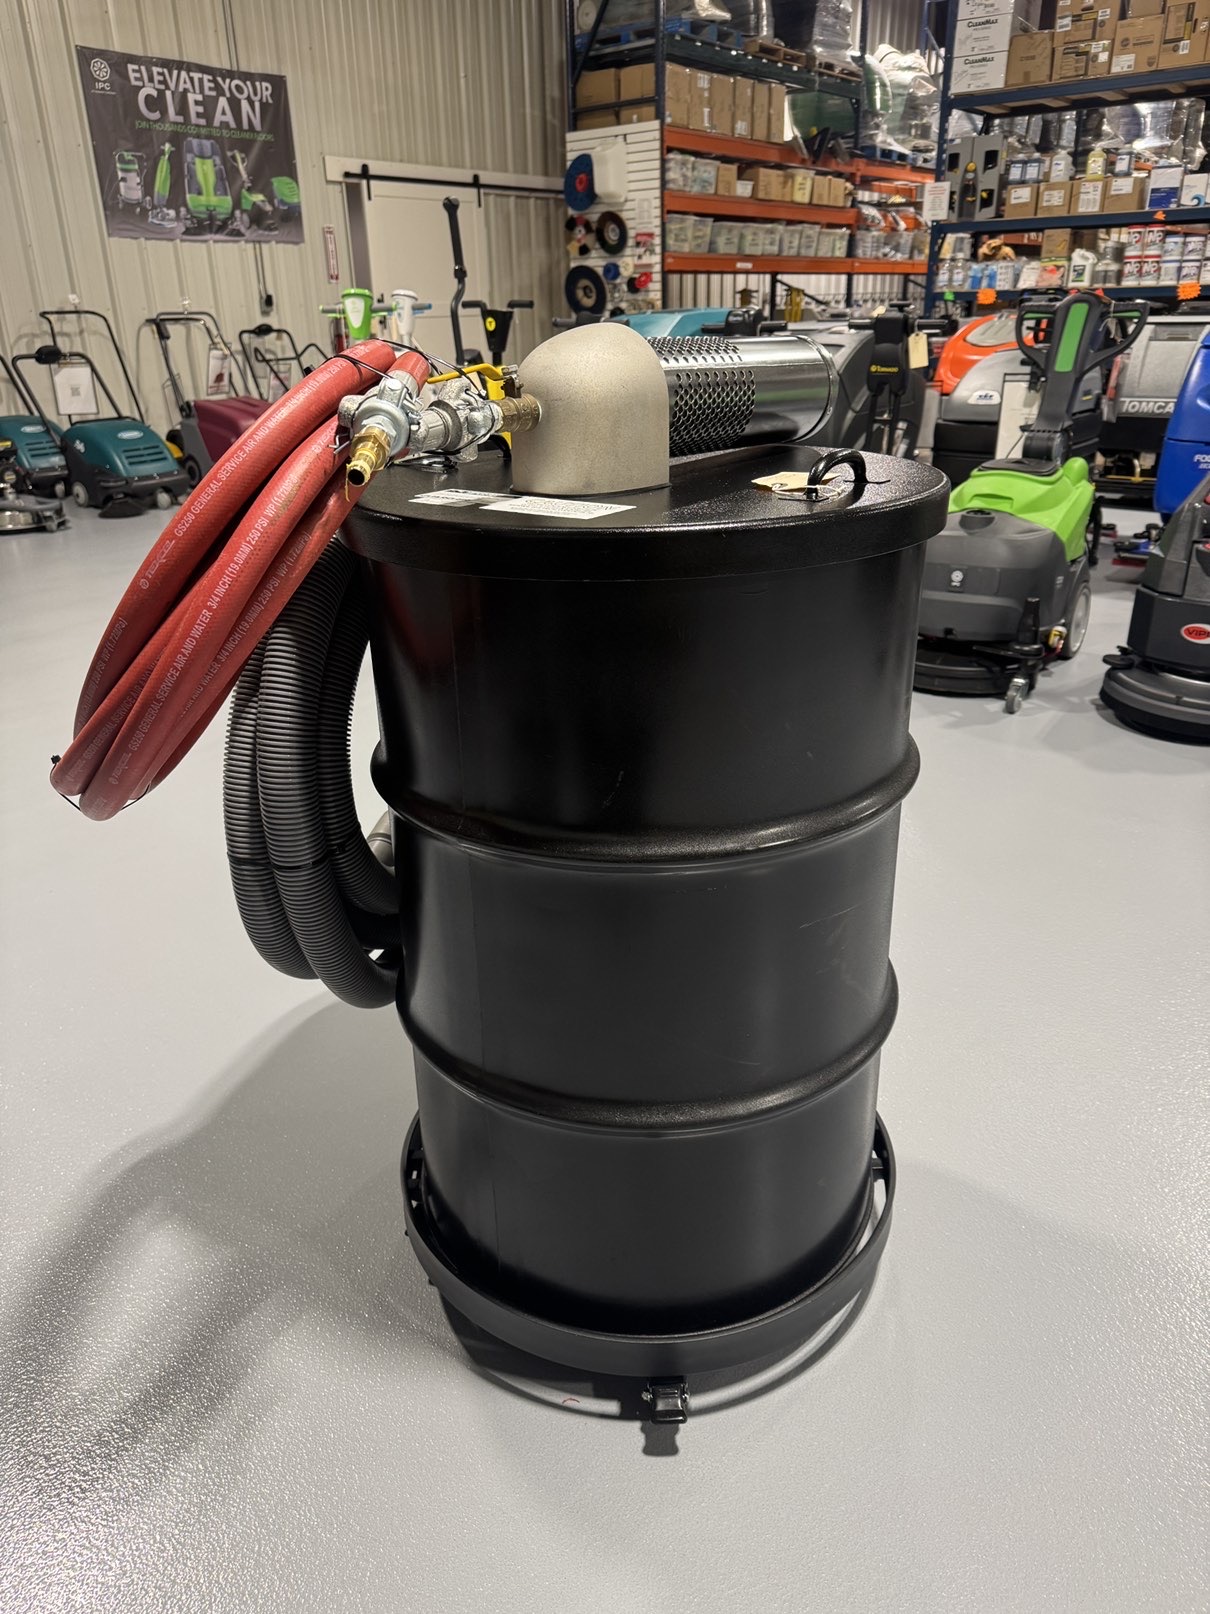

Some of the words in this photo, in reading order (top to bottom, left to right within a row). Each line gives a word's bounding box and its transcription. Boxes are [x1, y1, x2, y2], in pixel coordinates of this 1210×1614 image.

[95, 82, 111, 90] IPC
[127, 63, 217, 96] ELEVATE
[216, 77, 273, 103] YOUR
[138, 86, 262, 132] CLEAN
[174, 514, 195, 537] GS250
[190, 480, 223, 514] GENERAL
[217, 449, 247, 480] SERVICE
[245, 437, 258, 454] AIR
[253, 421, 270, 442] AND
[254, 516, 269, 532] PSI
[263, 503, 277, 519] WP
[246, 528, 261, 545] 250
[226, 541, 254, 577] (19.0MM)
[214, 574, 233, 597] INCH
[207, 593, 222, 610] 3/4
[191, 609, 213, 638] WATER
[202, 661, 221, 688] WATER
[217, 646, 229, 663] 3/4
[224, 628, 241, 649] INCH
[238, 601, 264, 636] (19.0MM)
[258, 587, 271, 605] 250
[268, 578, 280, 594] PSI
[277, 563, 288, 581] WP
[181, 637, 197, 657] AND
[174, 654, 188, 671] AIR
[156, 667, 180, 702] SERVICE
[111, 695, 136, 724] SERVICE
[138, 701, 163, 733] GENERAL
[128, 734, 145, 751] GS250
